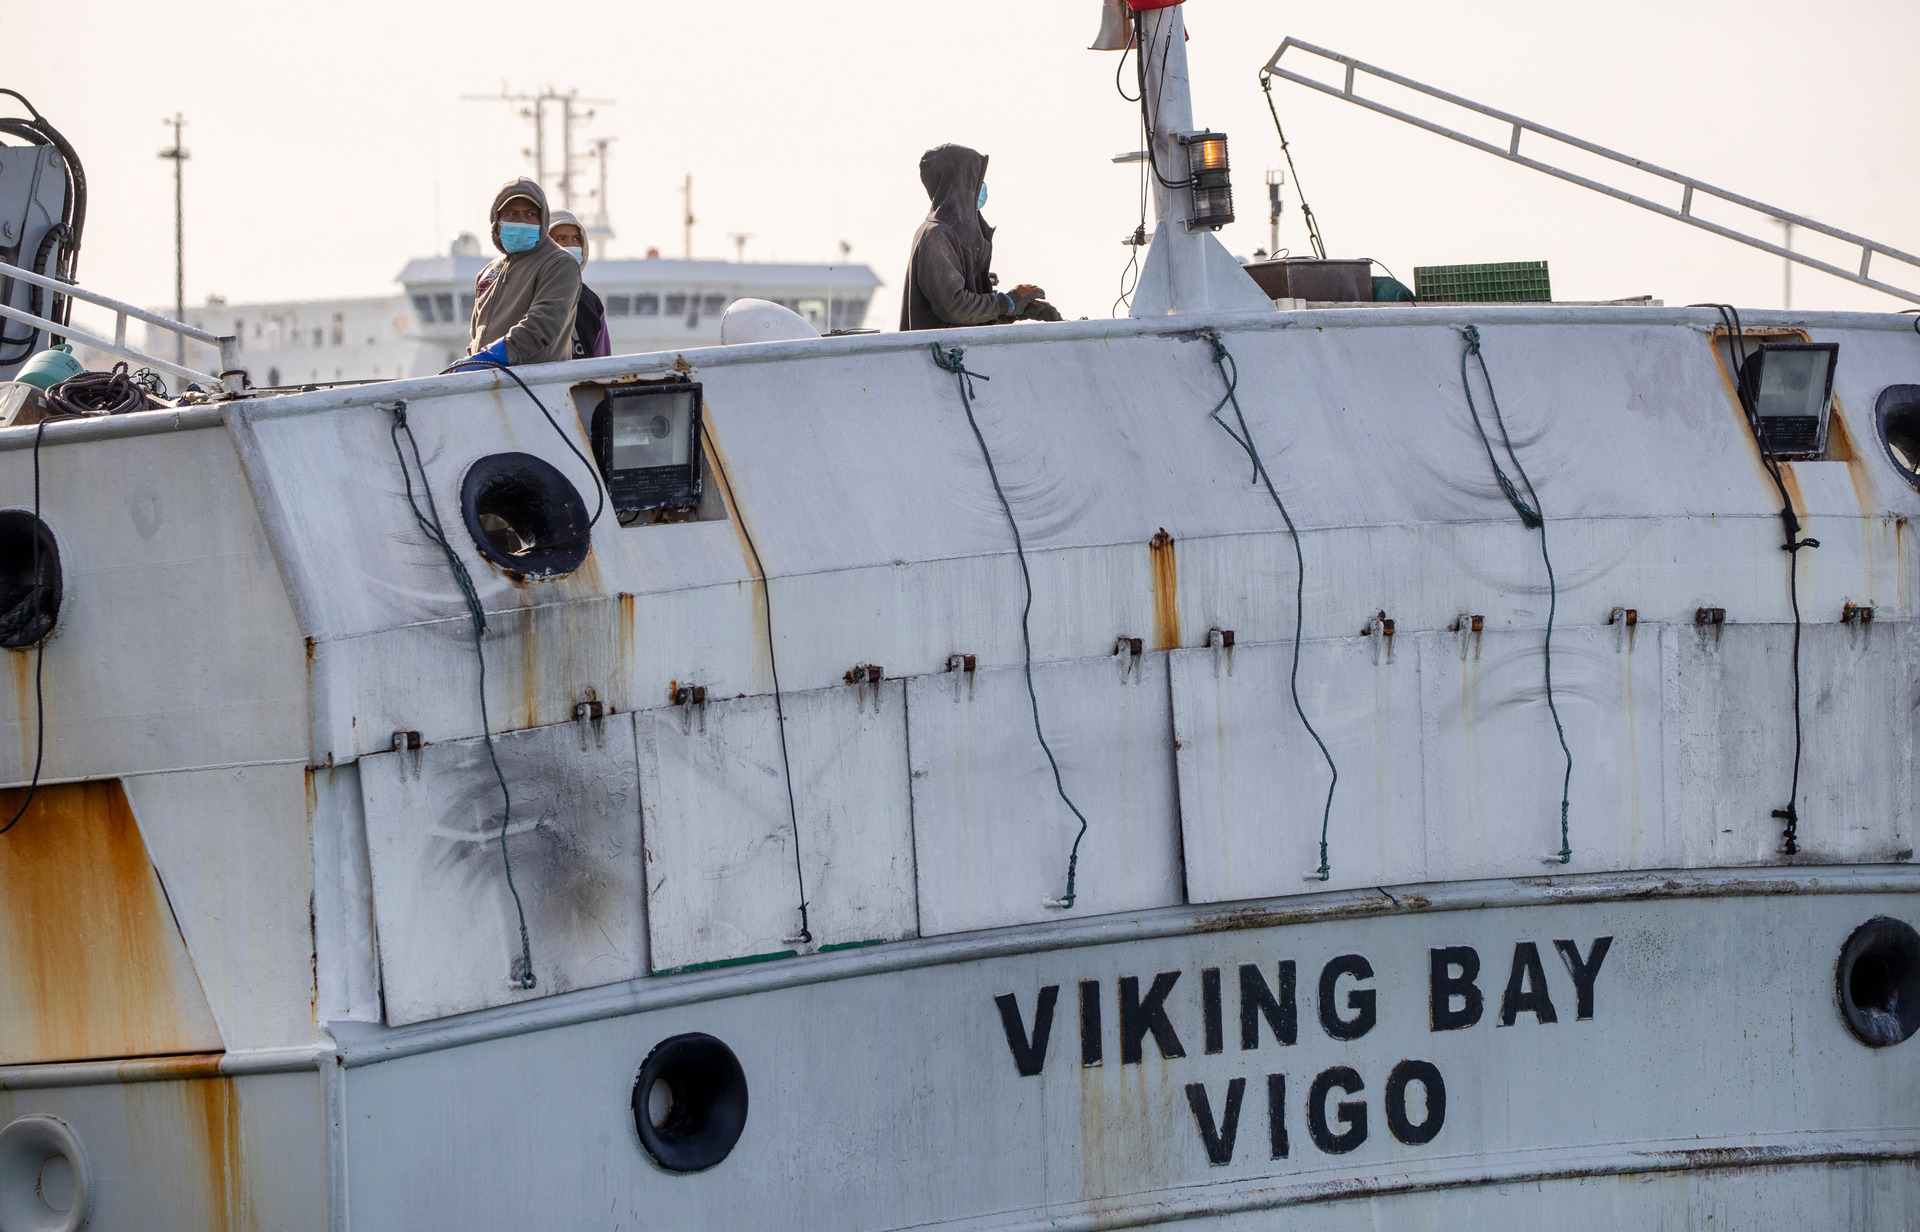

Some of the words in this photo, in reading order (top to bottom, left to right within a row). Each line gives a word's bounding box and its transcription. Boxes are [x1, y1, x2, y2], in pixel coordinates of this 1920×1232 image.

[994, 954, 1376, 1077] VIKING
[1429, 936, 1613, 1033] BAY
[1185, 1060, 1446, 1166] VIGO
